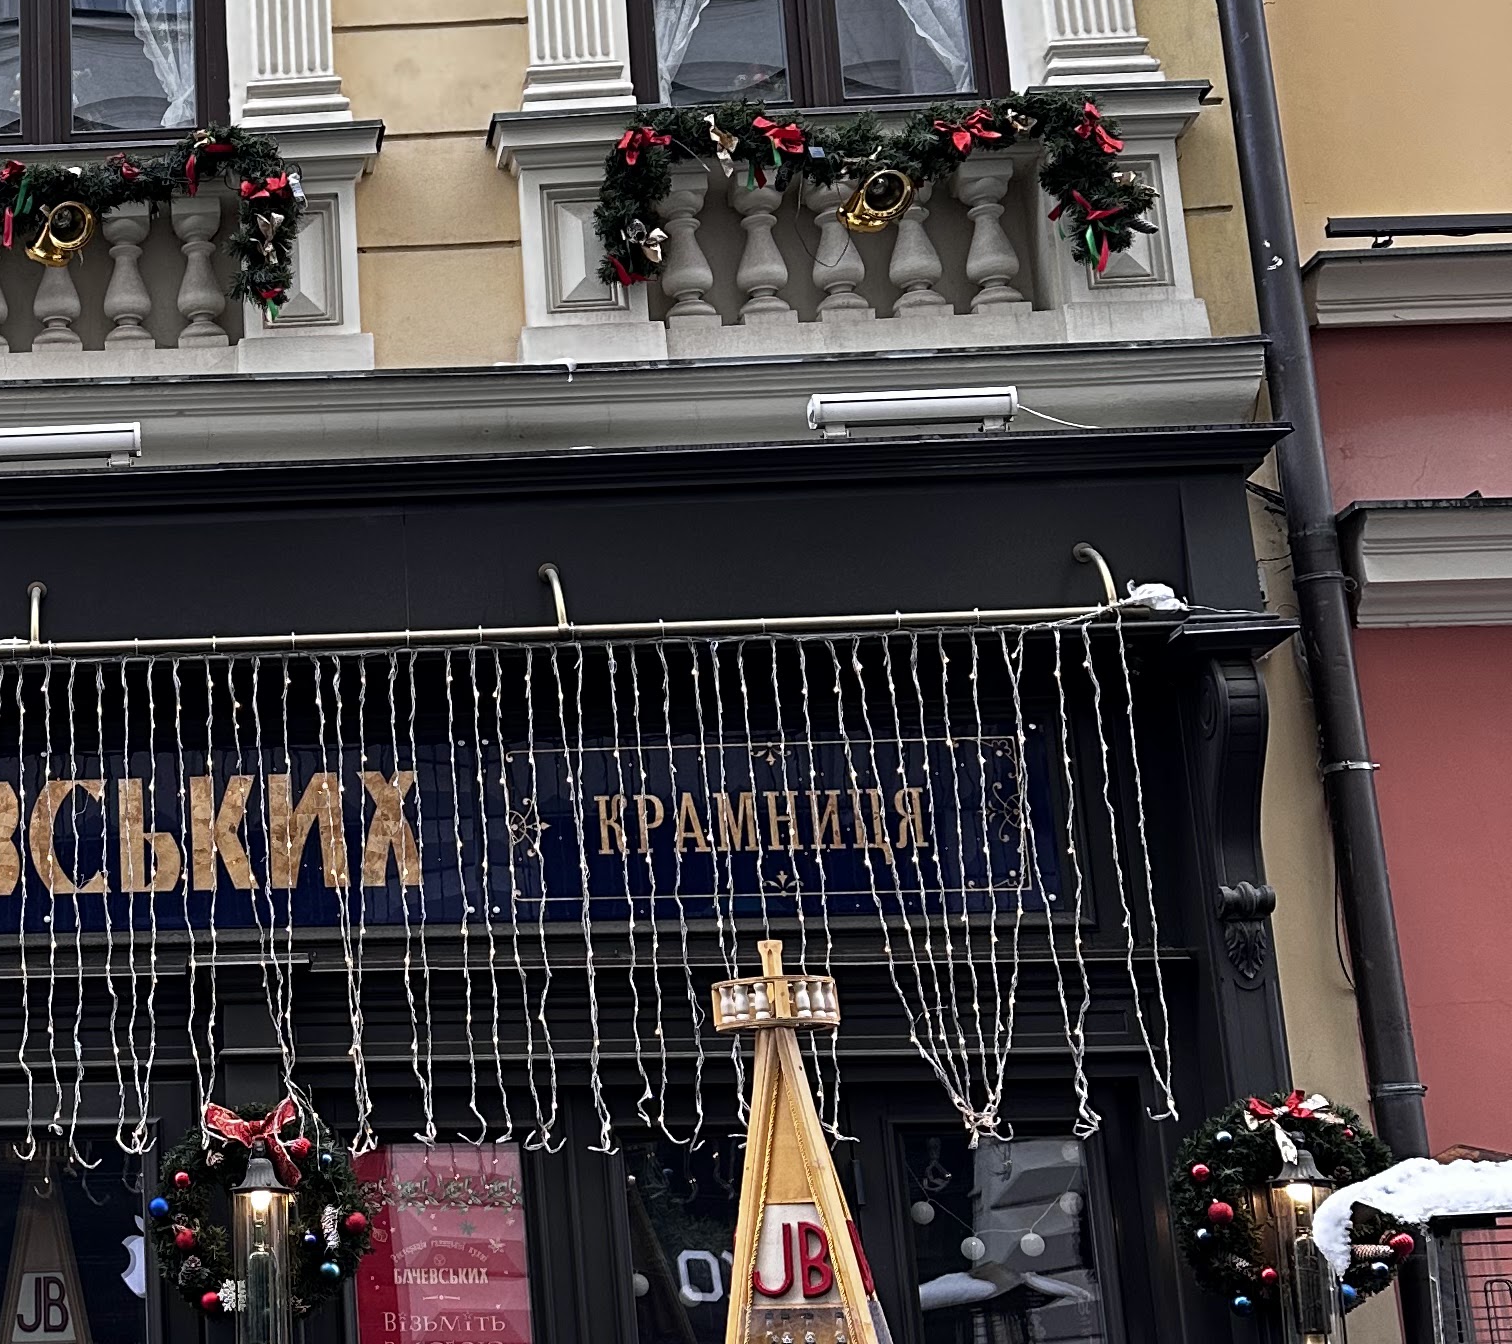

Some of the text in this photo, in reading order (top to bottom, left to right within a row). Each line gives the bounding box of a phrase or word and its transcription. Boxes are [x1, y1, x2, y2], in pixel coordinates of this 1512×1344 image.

[593, 786, 930, 865] КРАМНИЦЯ
[393, 1267, 489, 1285] БАЧЕВСЬКИХ
[753, 1221, 834, 1299] JB
[16, 1276, 69, 1333] JB
